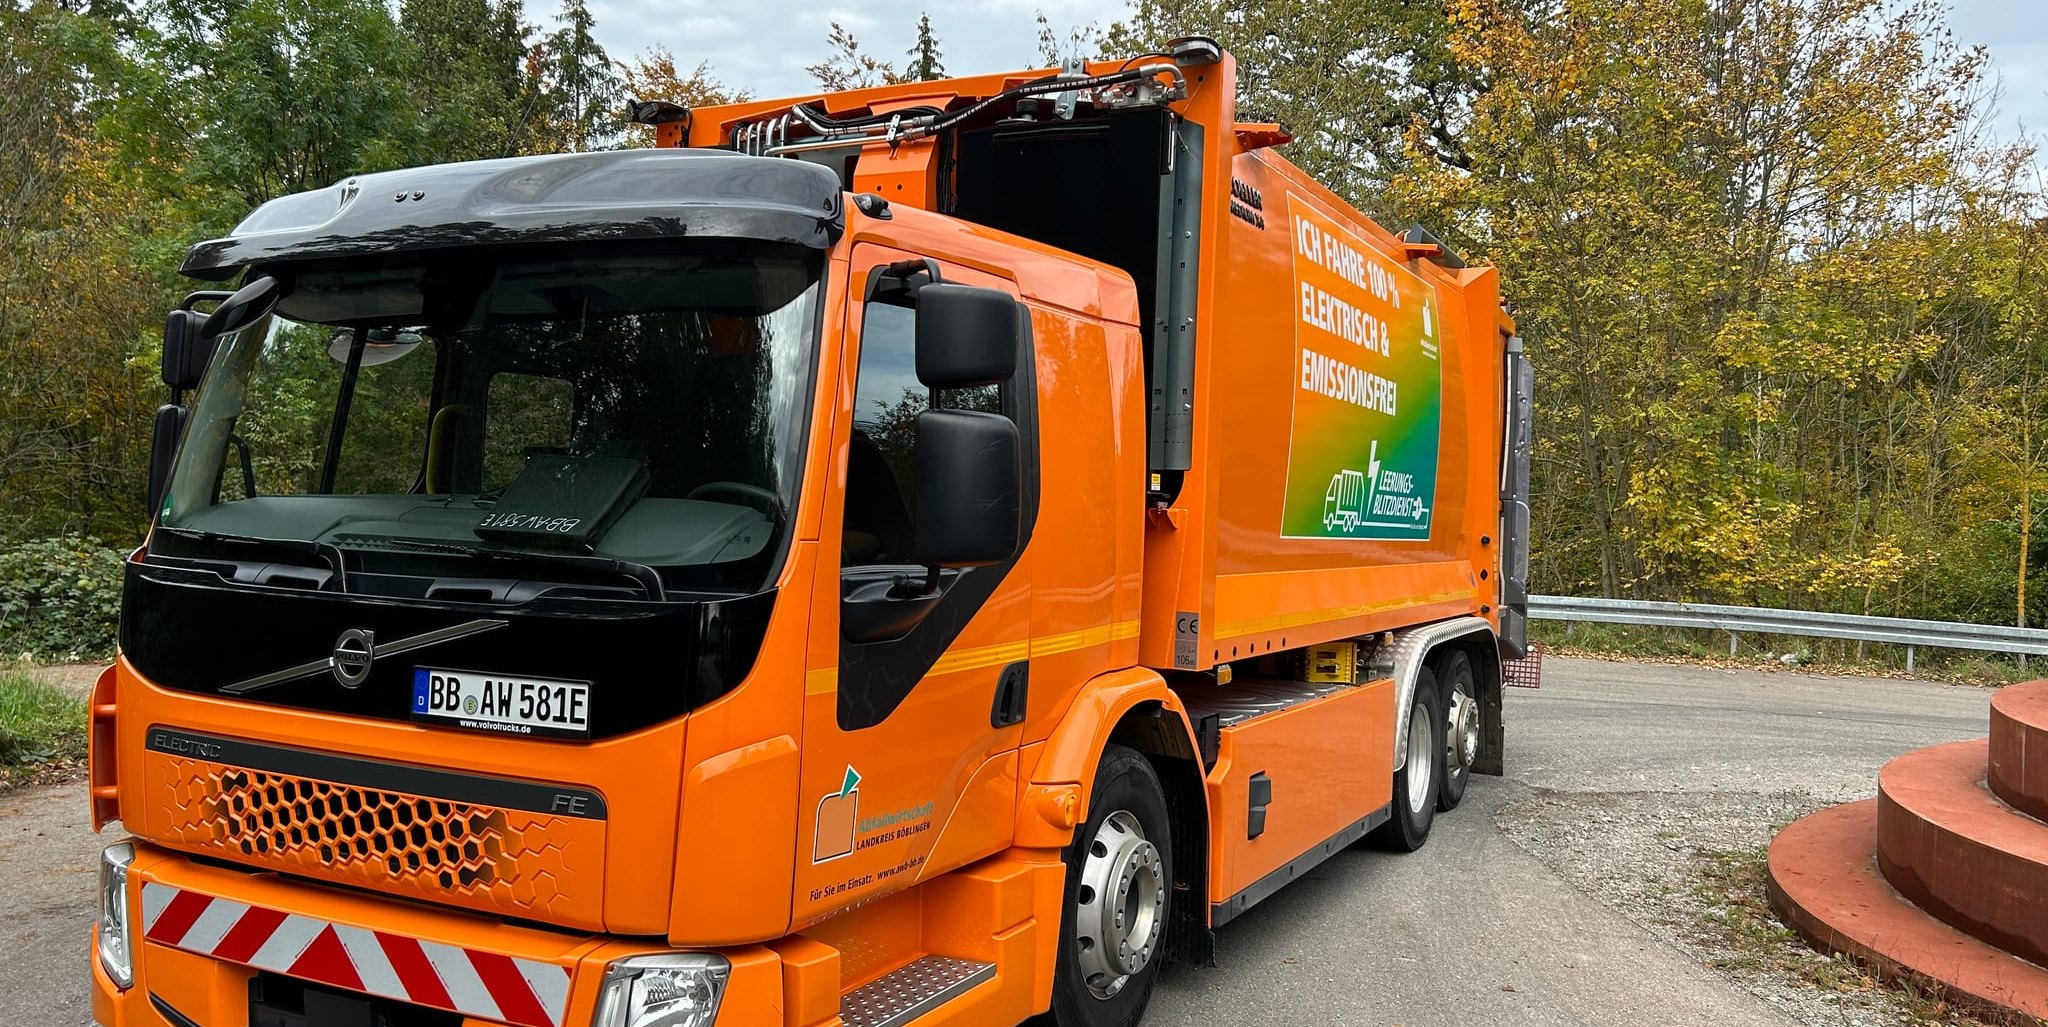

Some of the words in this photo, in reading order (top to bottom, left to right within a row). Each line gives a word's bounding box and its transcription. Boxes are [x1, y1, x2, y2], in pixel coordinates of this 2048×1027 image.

[1295, 214, 1323, 267] ICH
[1323, 231, 1367, 291] FAHRE
[1366, 260, 1388, 303] 100
[1388, 272, 1401, 310] %
[1300, 280, 1379, 353] ELEKTRISCH
[1380, 320, 1390, 358] &
[1300, 346, 1397, 417] EMISSIONSFREI
[1379, 469, 1414, 494] LEERUNGS-
[1372, 493, 1414, 517] BLITZDIENST
[1177, 617, 1199, 634] CE
[335, 650, 370, 662] VOLVO
[418, 695, 425, 706] D
[430, 675, 461, 712] BB
[480, 680, 513, 717] AW
[519, 683, 587, 725] 581E
[460, 719, 532, 734] www.volvotrucks.de
[155, 734, 221, 758] ELECTRIC
[551, 794, 589, 815] FE
[858, 801, 935, 833] Abfallwirtschaft
[856, 831, 895, 851] LANDKREIS
[896, 820, 931, 840] BÖBLINGEN
[809, 886, 823, 902] Für
[824, 885, 835, 898] Sie
[836, 881, 846, 892] im
[848, 874, 874, 889] Einsatz.
[877, 855, 925, 881] www.awb-bb.de
